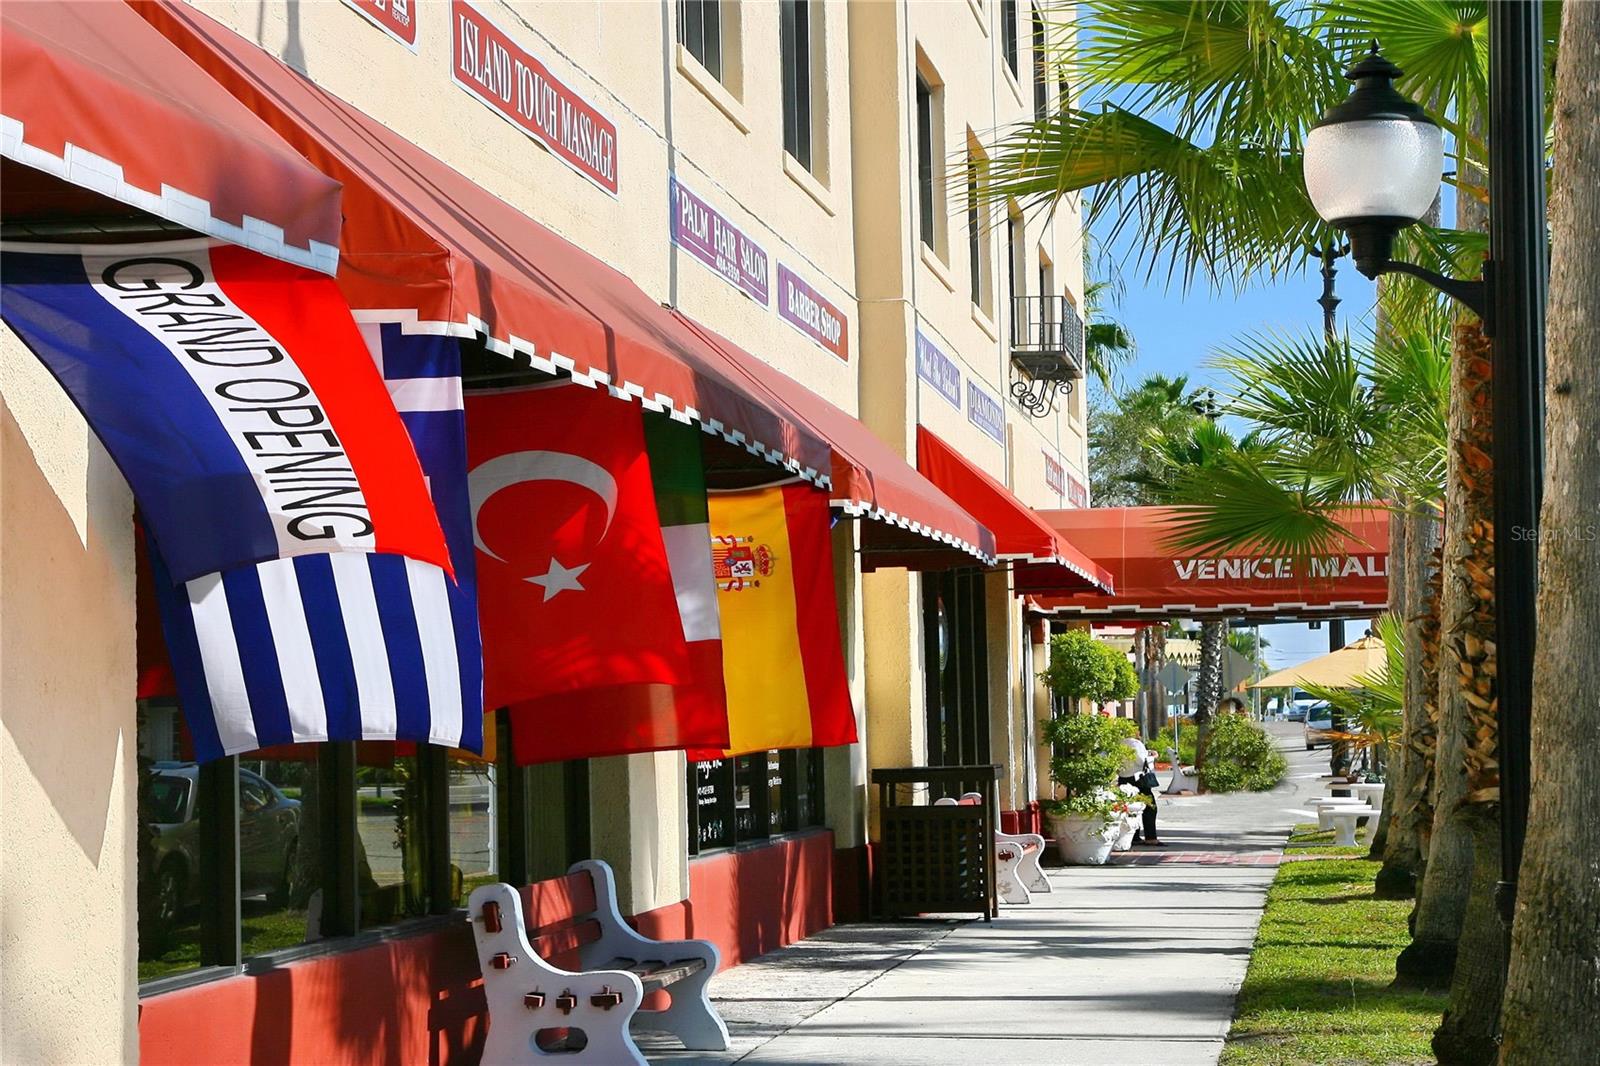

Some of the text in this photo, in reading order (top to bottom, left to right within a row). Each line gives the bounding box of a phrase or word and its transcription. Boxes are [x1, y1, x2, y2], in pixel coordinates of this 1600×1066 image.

[459, 13, 614, 183] ISLAND TOUCH MASSAGE
[681, 189, 767, 288] PALM HAIR SALON
[787, 279, 842, 347] BARBER SHOP
[101, 257, 375, 541] GRAND OPENING
[1172, 557, 1293, 580] VENICE
